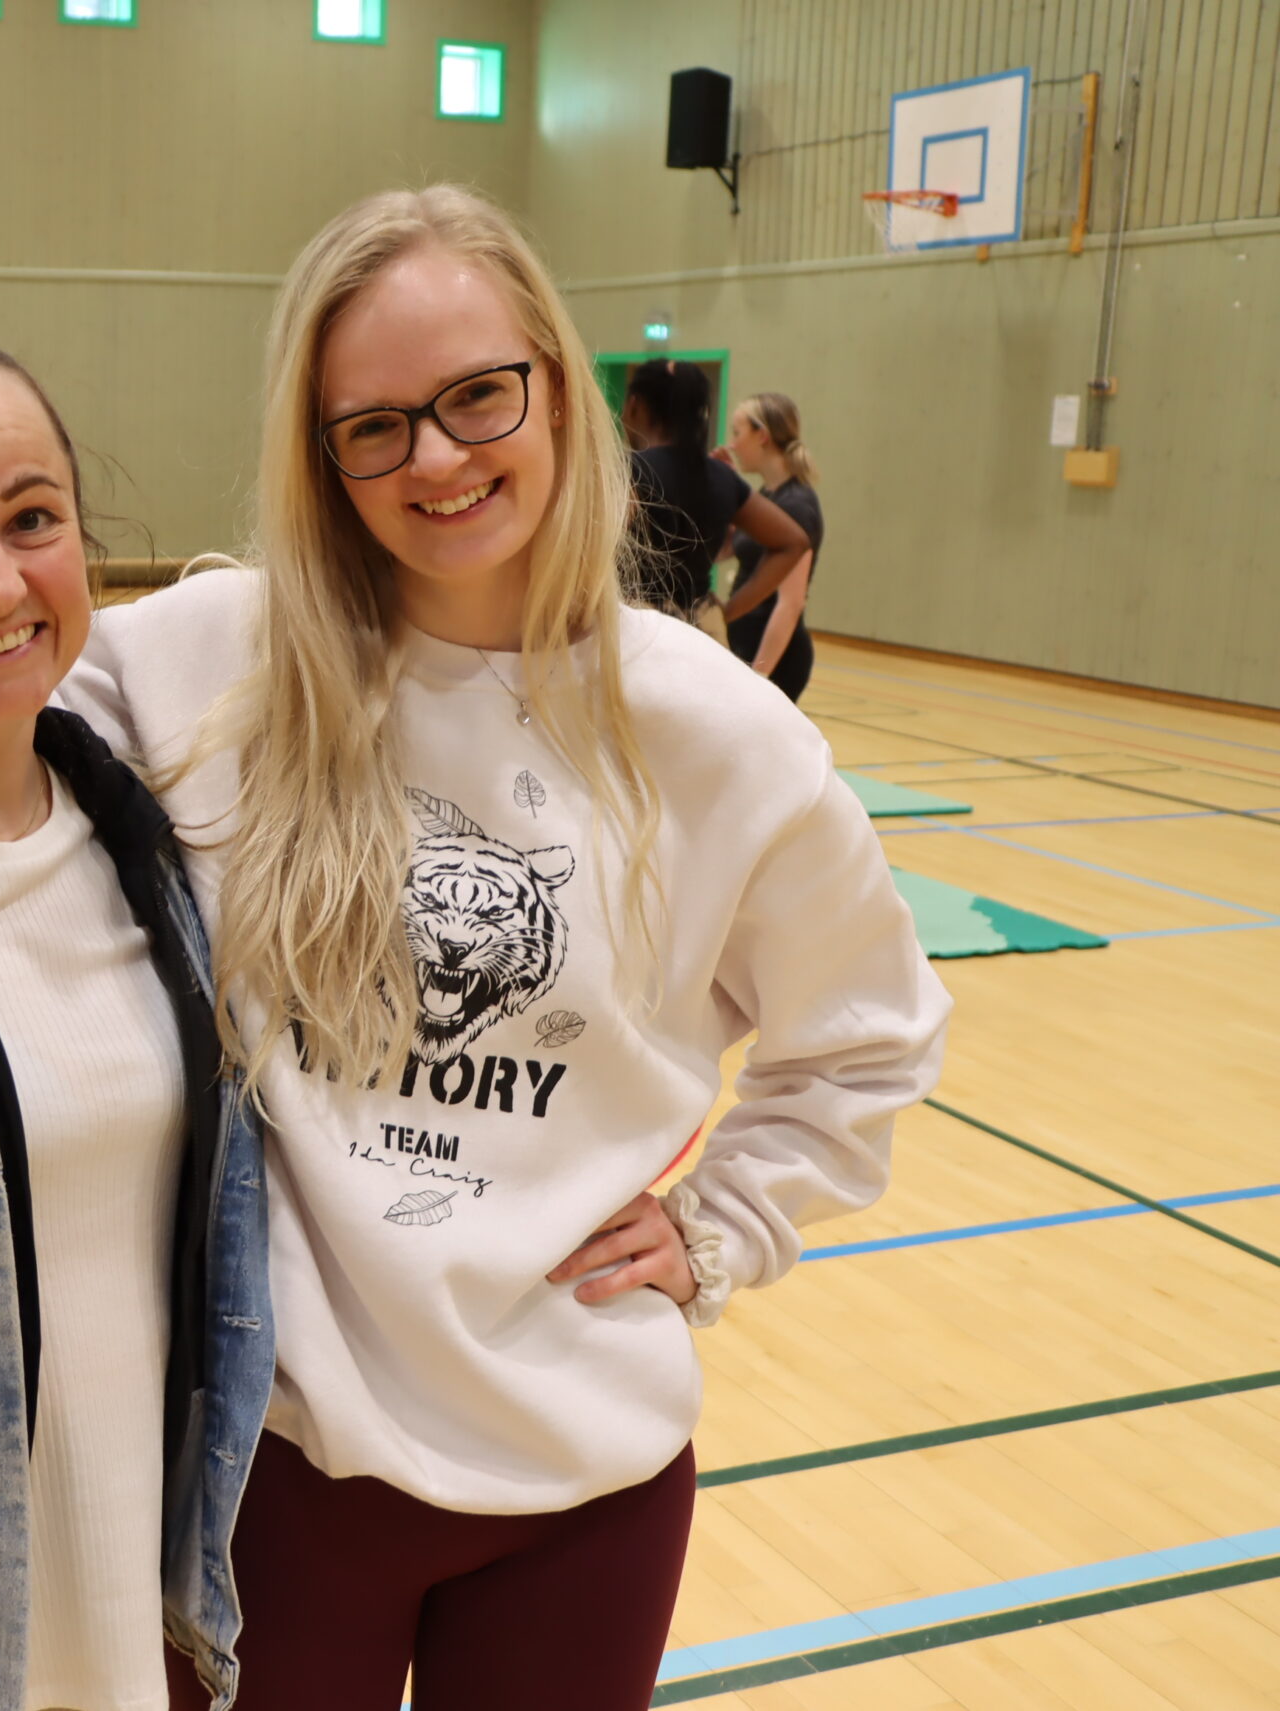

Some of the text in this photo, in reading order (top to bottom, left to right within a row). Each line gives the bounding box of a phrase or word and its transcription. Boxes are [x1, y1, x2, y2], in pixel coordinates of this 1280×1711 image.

[288, 1016, 568, 1118] VTORY
[379, 1122, 460, 1162] TEAM
[409, 1157, 494, 1198] Craig
